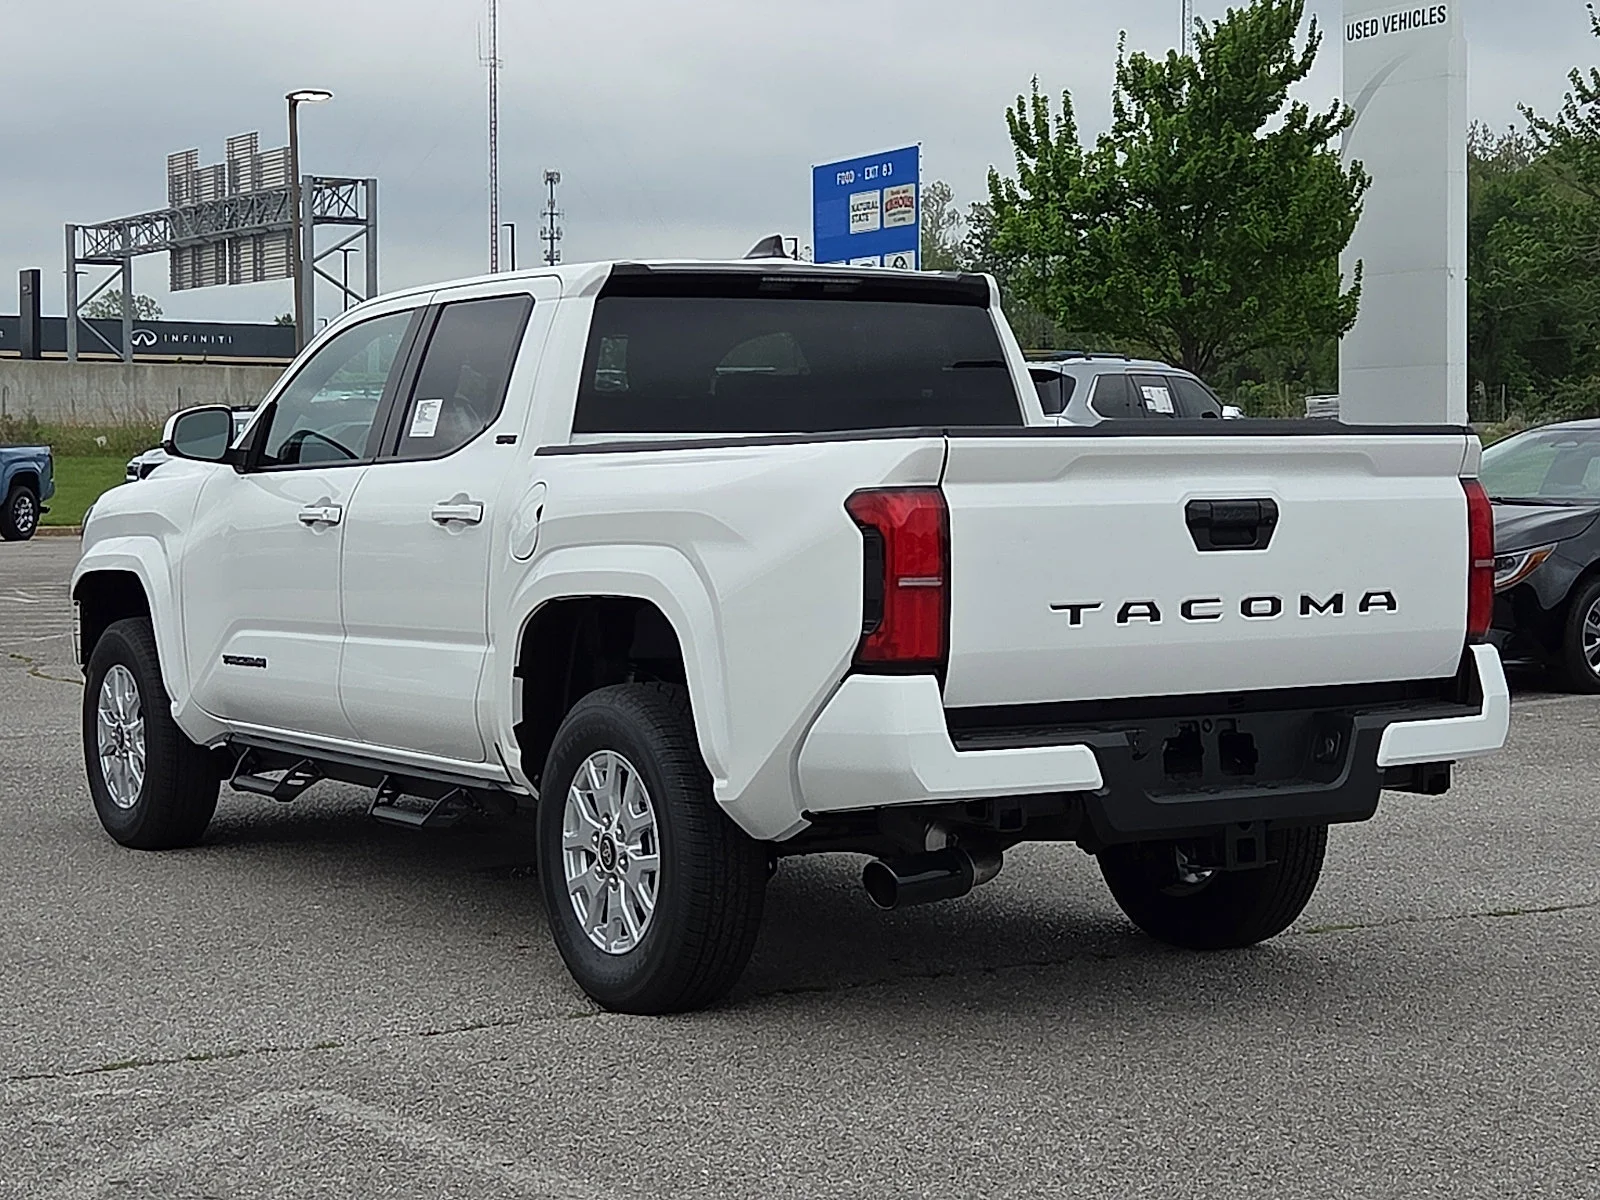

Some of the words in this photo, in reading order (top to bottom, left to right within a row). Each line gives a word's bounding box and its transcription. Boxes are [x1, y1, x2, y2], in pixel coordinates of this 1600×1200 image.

[1346, 18, 1379, 41] USED
[1382, 4, 1447, 34] VEHICLES
[836, 170, 855, 185] FOOD
[864, 165, 879, 180] EXIT
[851, 200, 879, 212] NATURAL
[851, 213, 869, 223] STATE
[163, 333, 234, 344] INFINITI
[1050, 590, 1398, 627] TACOMA
